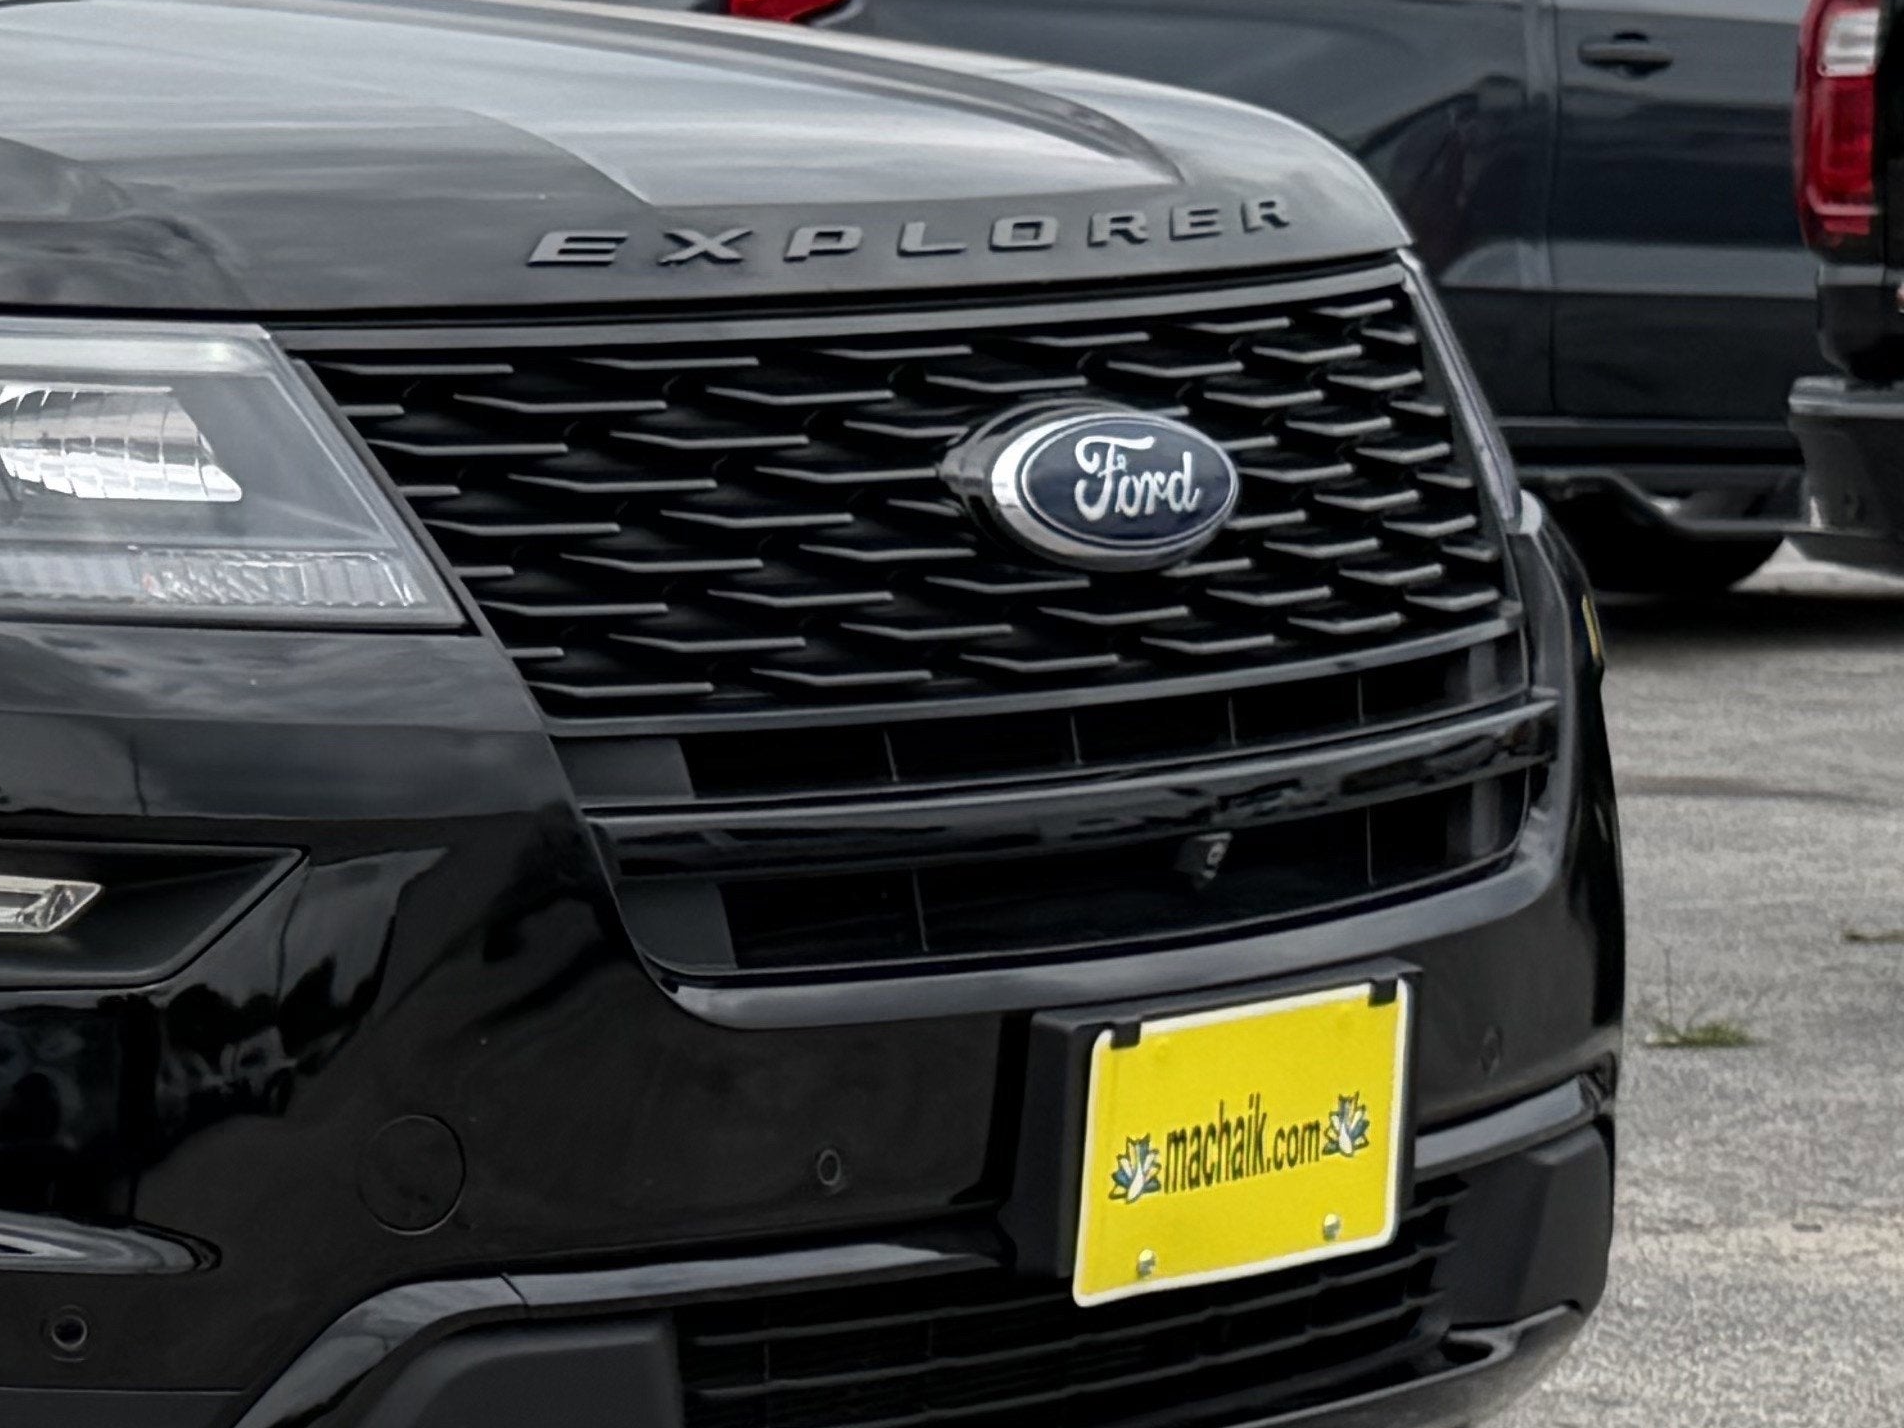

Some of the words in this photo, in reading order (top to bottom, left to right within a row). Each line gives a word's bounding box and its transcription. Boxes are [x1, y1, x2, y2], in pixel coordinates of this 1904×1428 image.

[527, 196, 1292, 266] EXPLORER
[1074, 435, 1200, 521] Ford
[1163, 1092, 1322, 1194] machaik.com
